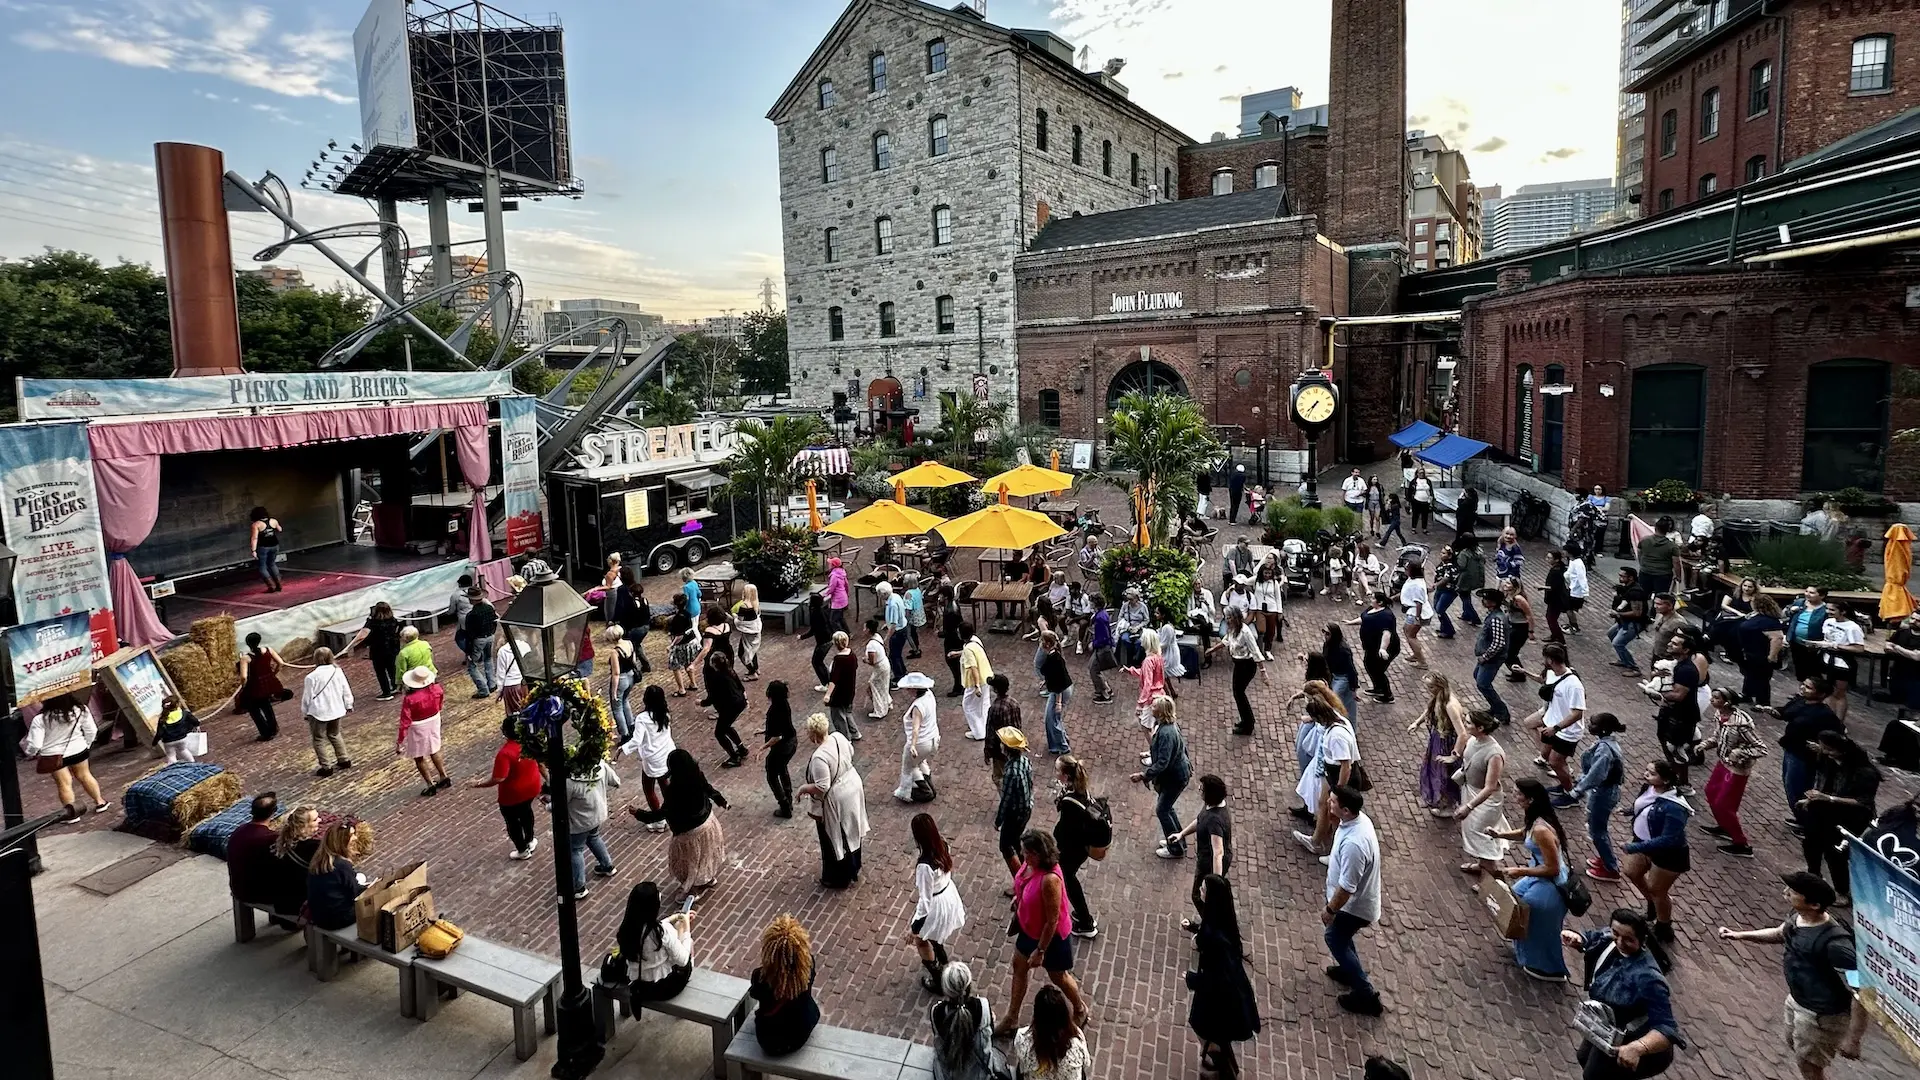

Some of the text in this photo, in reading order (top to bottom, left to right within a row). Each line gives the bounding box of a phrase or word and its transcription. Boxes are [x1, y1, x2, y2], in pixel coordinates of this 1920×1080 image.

[1109, 290, 1183, 313] JOHN FLUEVOG
[229, 375, 408, 405] PICKS AND BRICKS
[507, 437, 525, 452] PICKS
[512, 442, 534, 462] BRICKS
[12, 490, 77, 518] PICKS AND
[28, 497, 88, 533] BRICKS
[23, 532, 56, 541] COUNTRY
[41, 540, 75, 554] LIVE
[20, 546, 96, 565] PERFORMANCES
[26, 567, 57, 578] MONDAY
[22, 646, 84, 674] YEEHAW
[1885, 885, 1914, 915] PICKS
[1856, 911, 1917, 965] HOLD YOUR
[1864, 954, 1884, 978] THE
[1866, 944, 1917, 992] STOP AND
